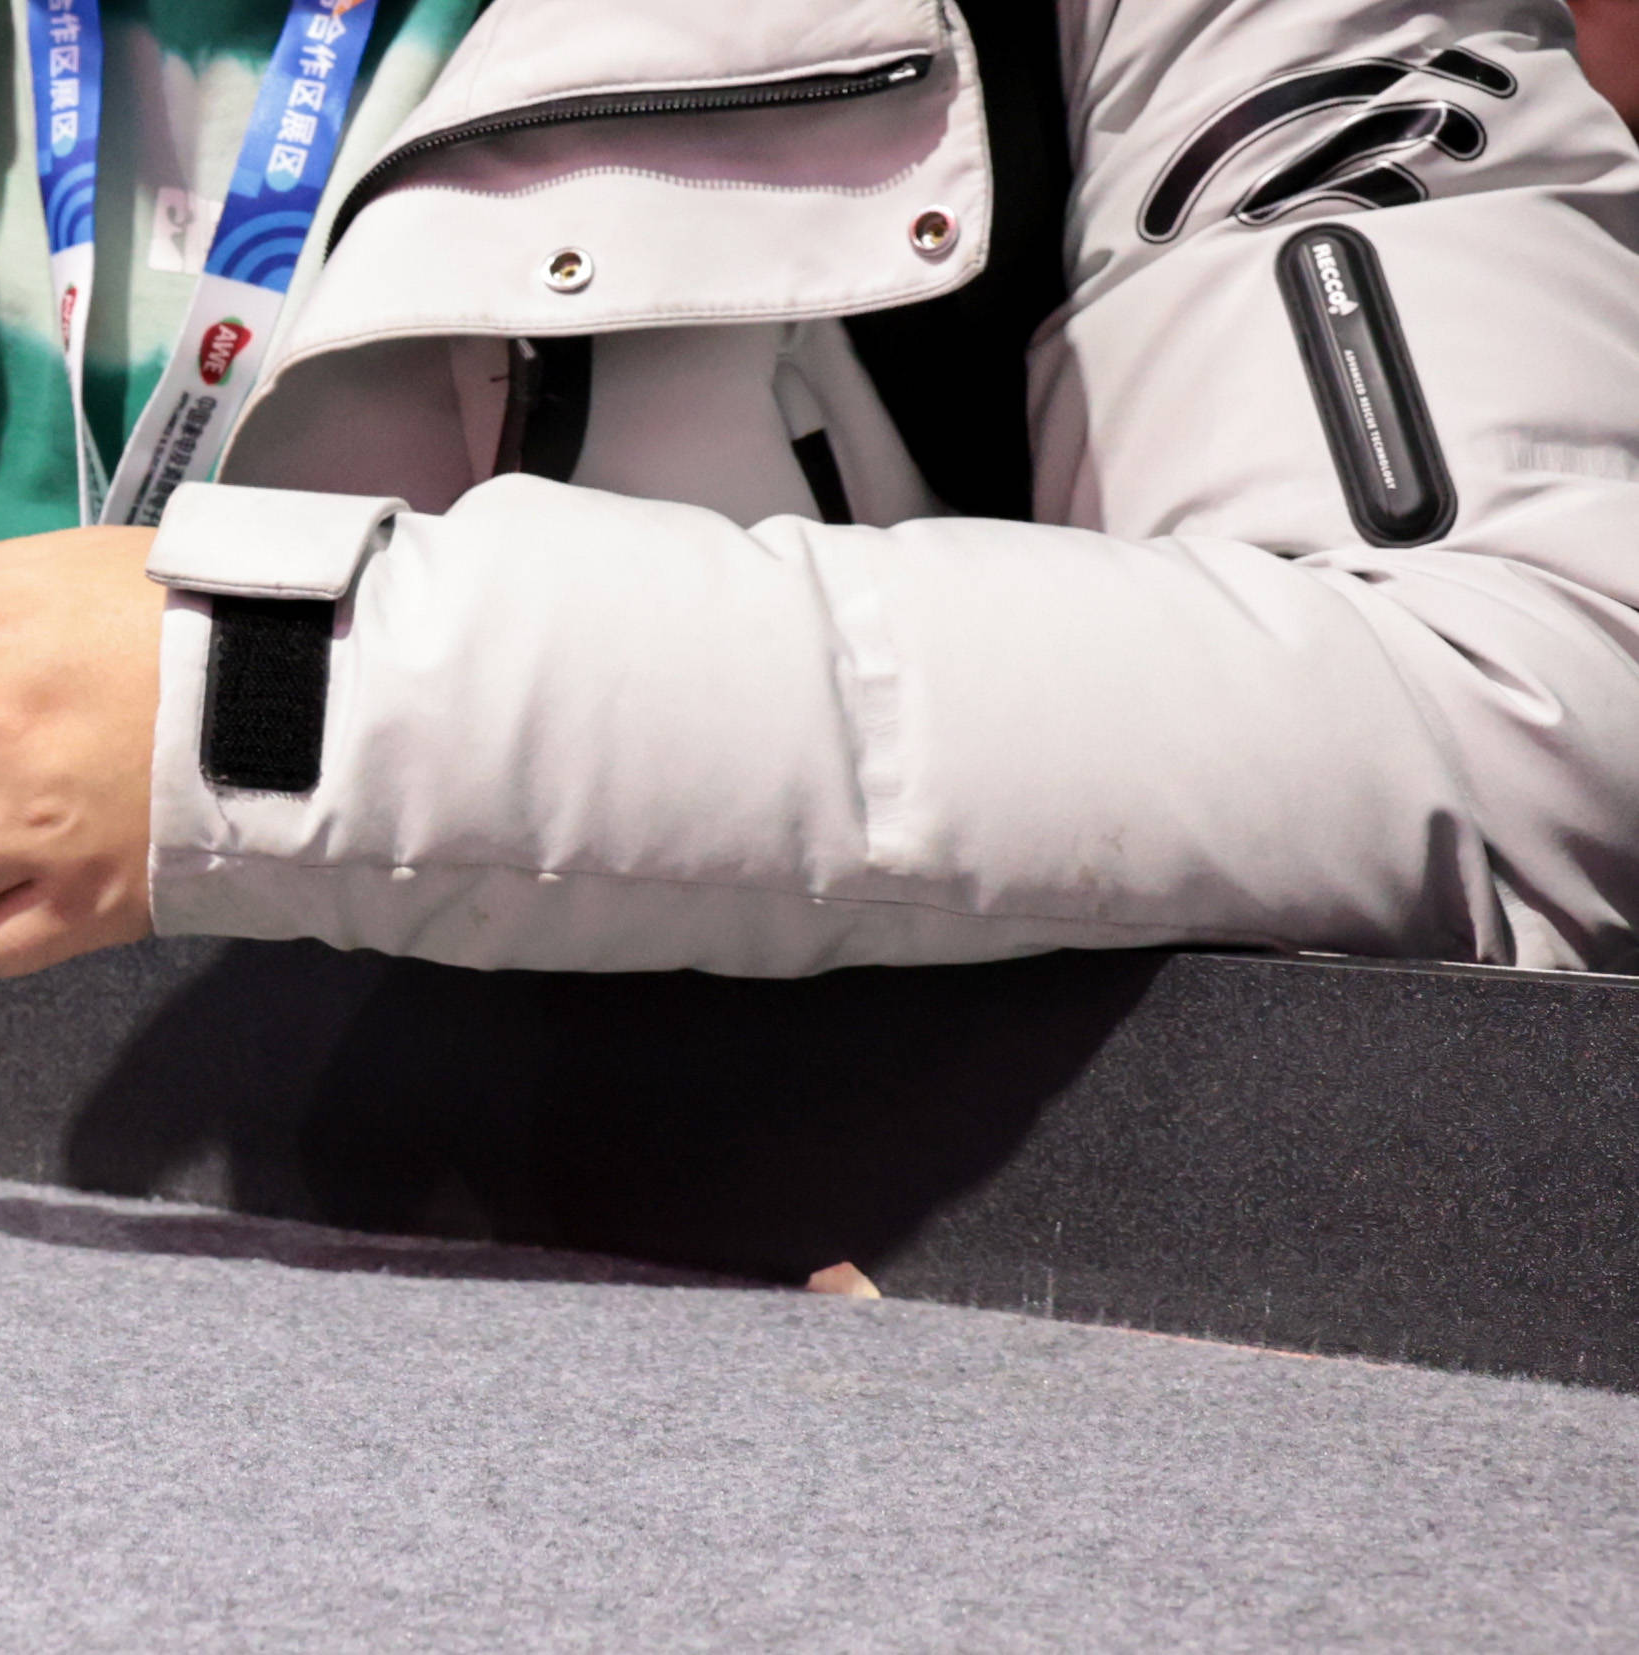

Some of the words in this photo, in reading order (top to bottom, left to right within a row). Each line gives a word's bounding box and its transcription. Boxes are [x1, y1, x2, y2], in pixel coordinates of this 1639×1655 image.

[1312, 243, 1348, 306] RECCO
[203, 324, 238, 376] AWE
[1344, 349, 1367, 395] ADVANCED
[1359, 396, 1378, 430] RESCUE
[1370, 431, 1397, 490] TECHNOLOGY
